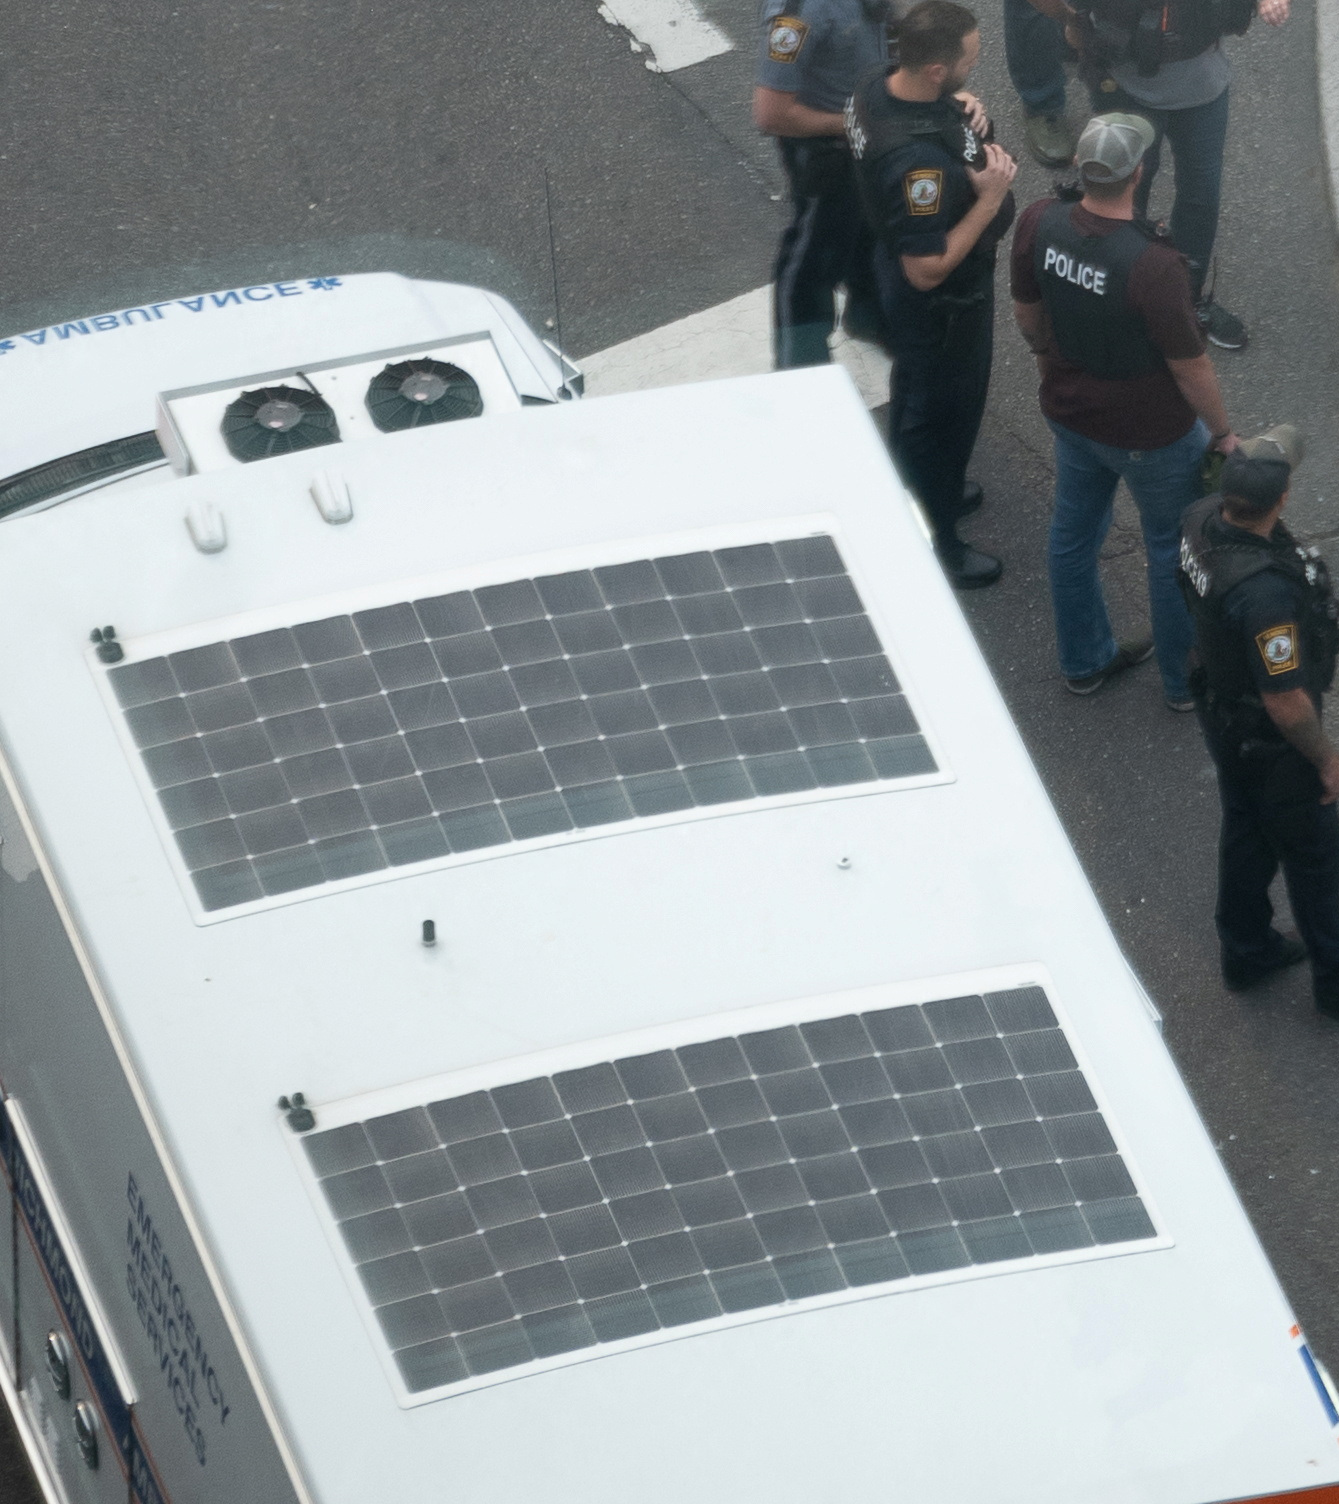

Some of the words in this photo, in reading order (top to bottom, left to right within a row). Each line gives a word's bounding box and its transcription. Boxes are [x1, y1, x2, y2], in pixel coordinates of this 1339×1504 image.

[1044, 247, 1106, 295] POLICE
[126, 1217, 200, 1411] MEDICAL
[126, 1263, 206, 1468] SERVICES
[127, 1170, 230, 1426] EMERGENCY
